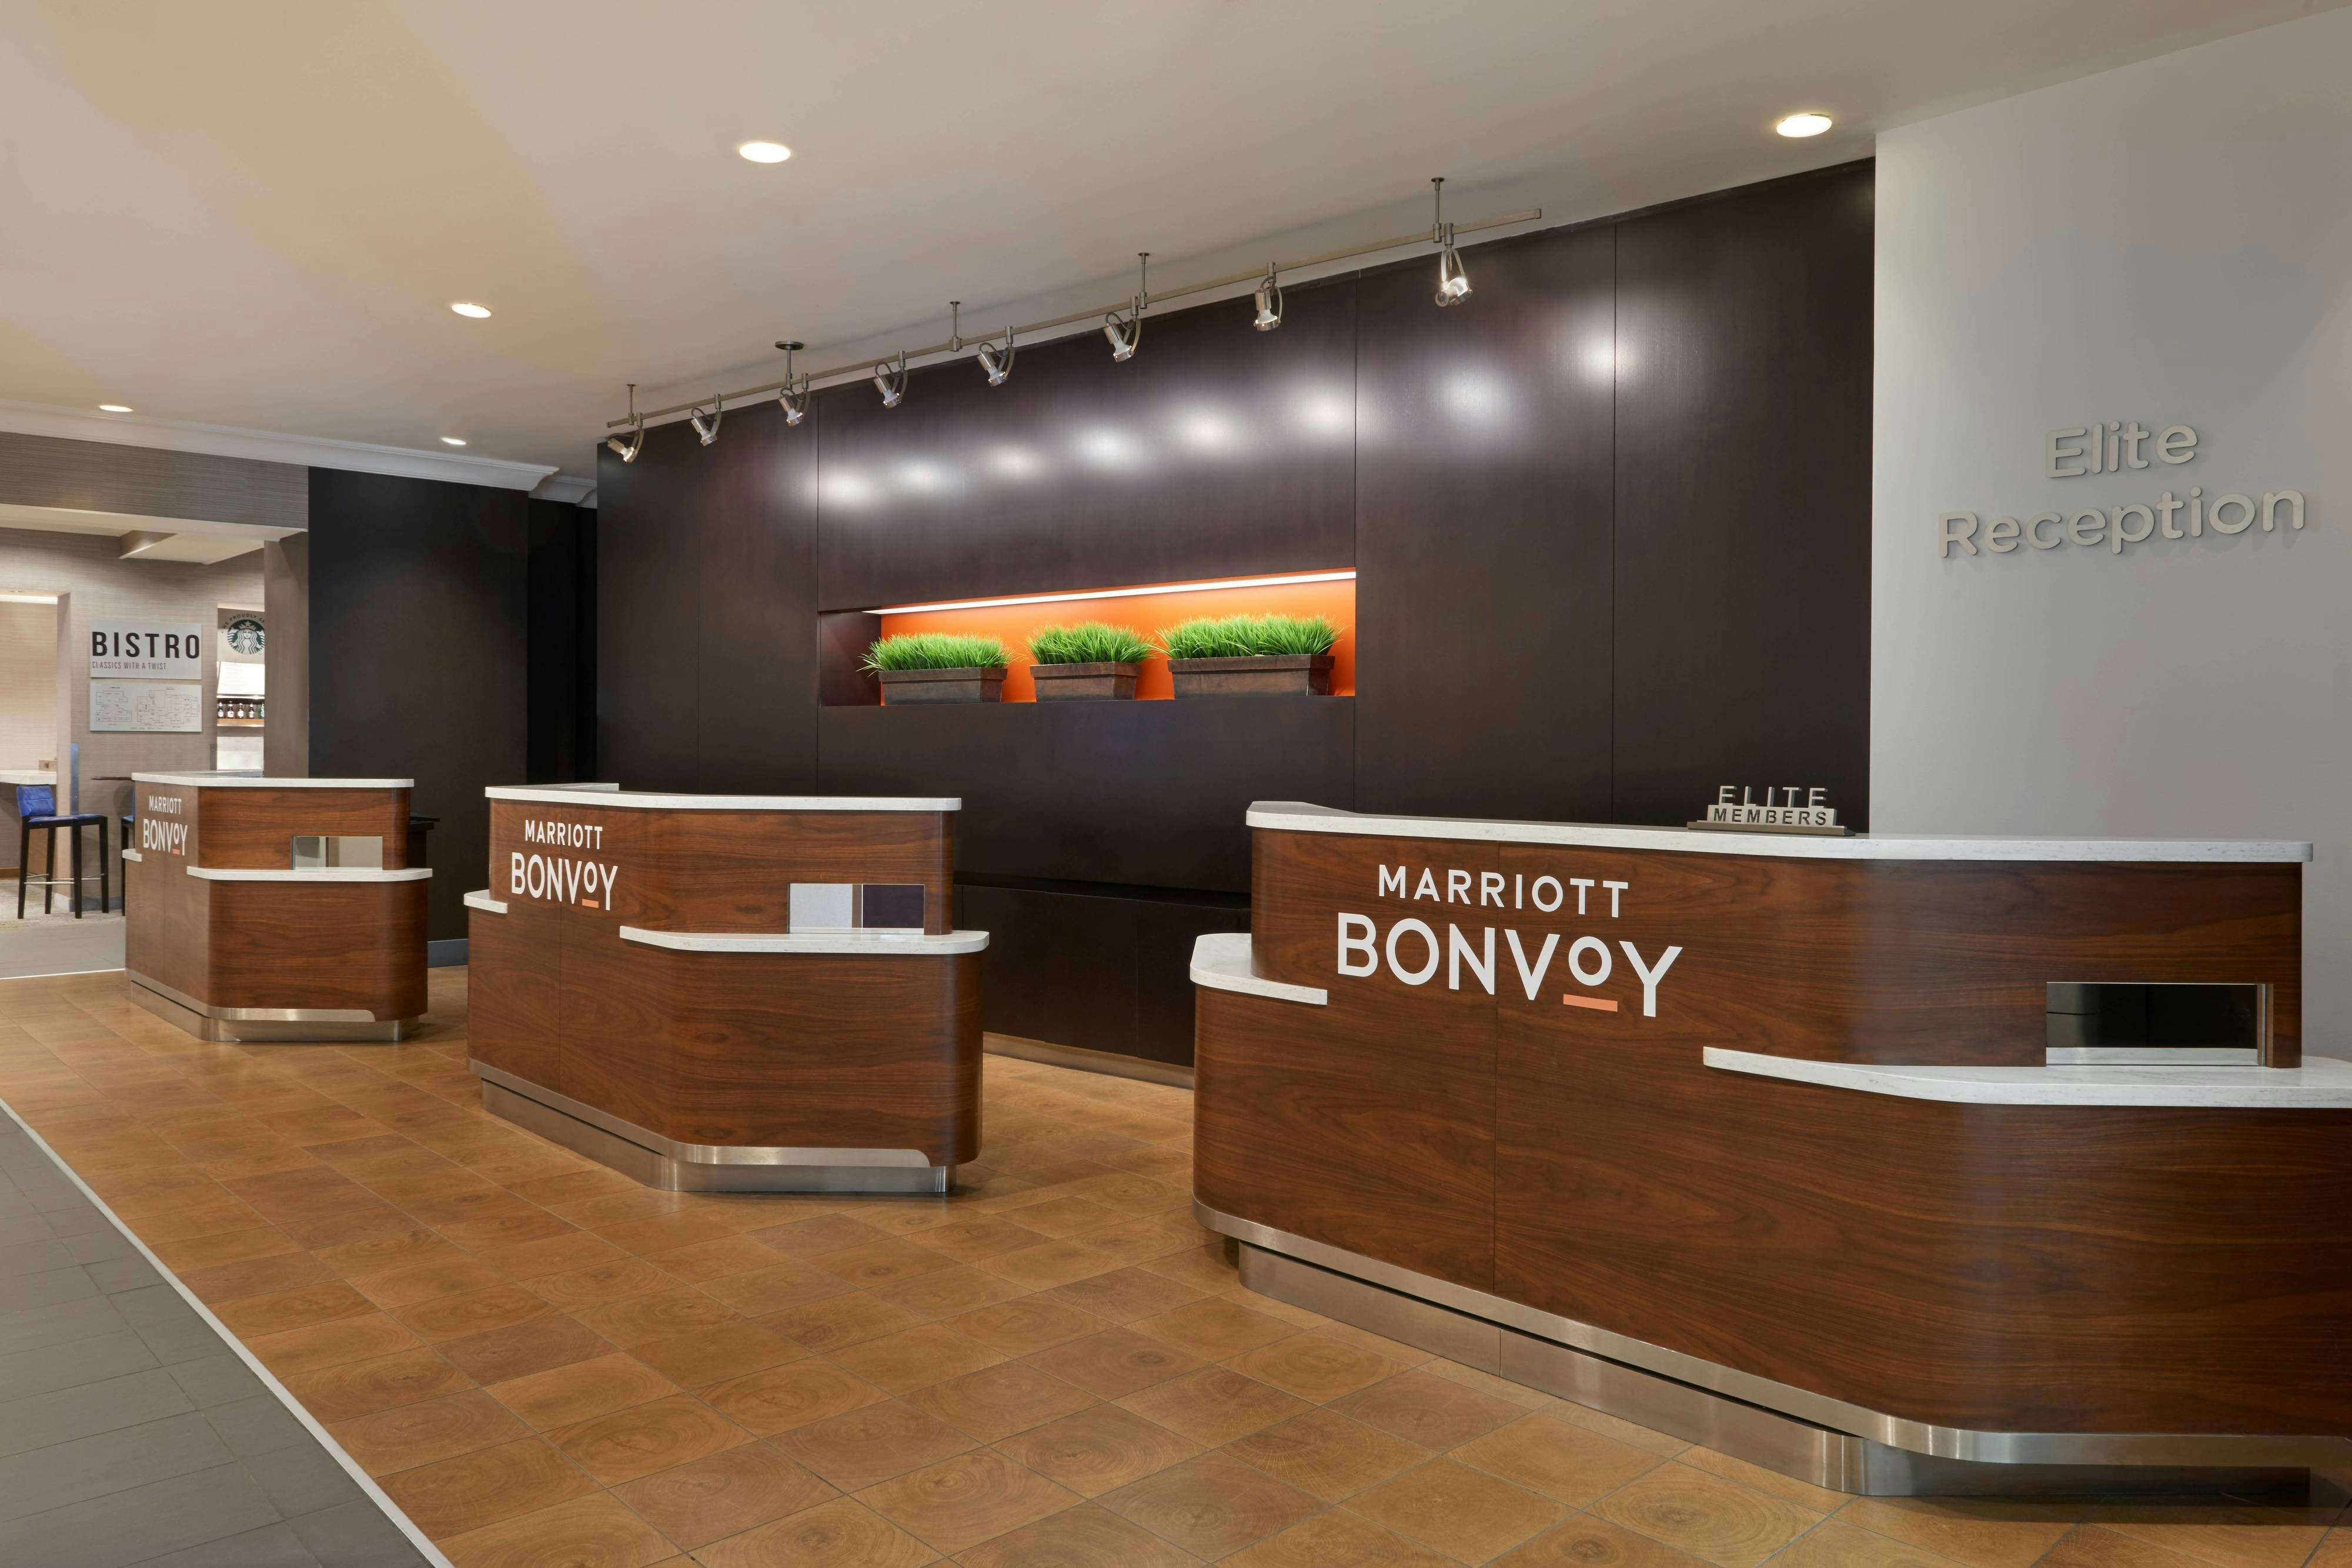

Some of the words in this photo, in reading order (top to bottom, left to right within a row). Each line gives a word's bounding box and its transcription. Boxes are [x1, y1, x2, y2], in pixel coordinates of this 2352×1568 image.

[2046, 421, 2198, 478] Elite
[1939, 486, 2304, 558] Reception
[92, 631, 200, 658] BISTRO
[149, 795, 182, 814] MARRIOTT
[1718, 785, 1828, 808] ELITE
[525, 820, 603, 850] MARRIOTT
[1713, 808, 1827, 825] MEMBERS
[143, 818, 188, 856] BONVOY
[512, 852, 618, 911] BONVOY
[1379, 864, 1628, 918] MARRIOTT
[1338, 912, 1683, 1017] BONVOY
